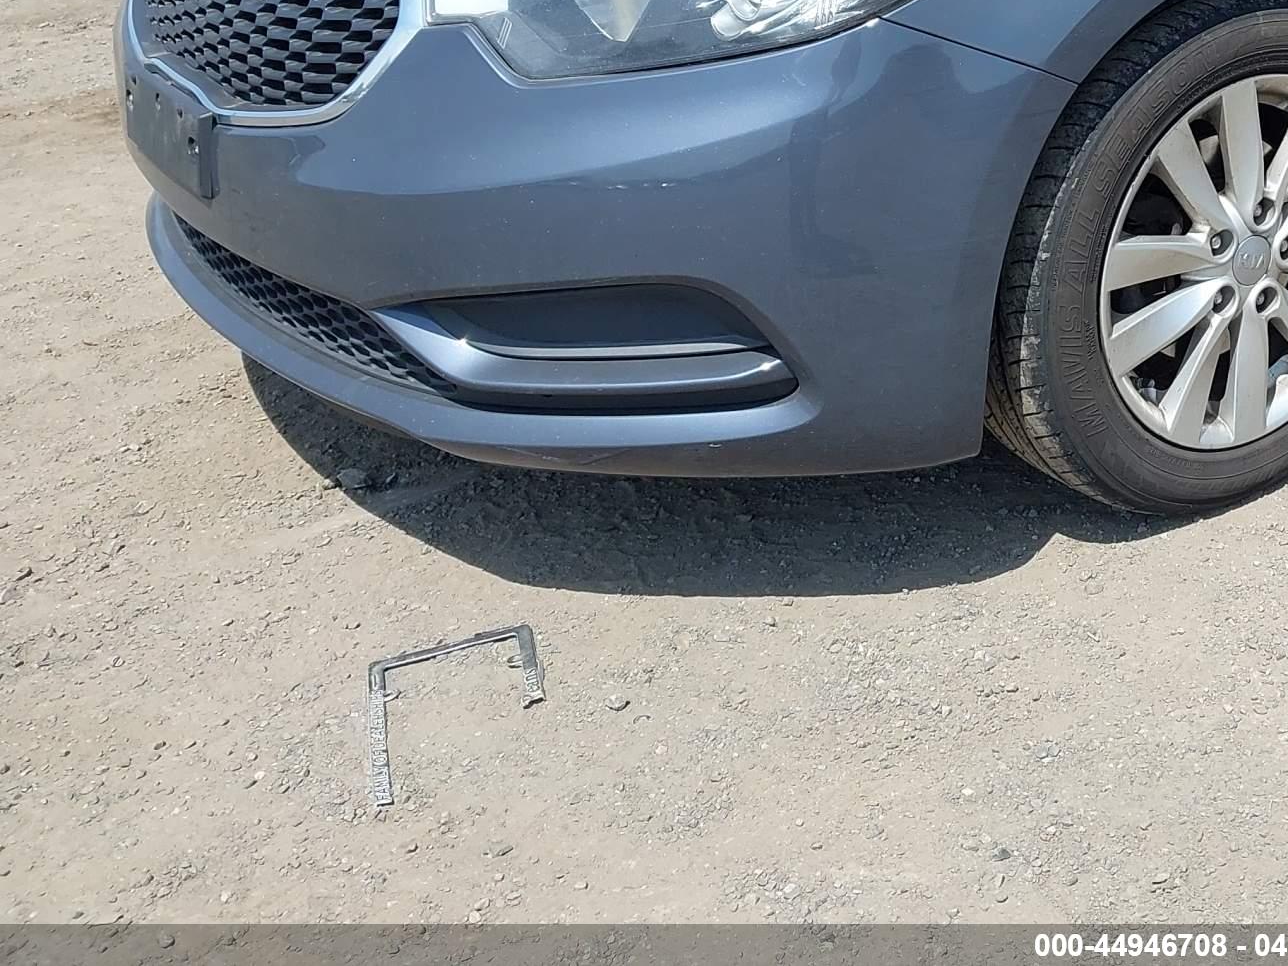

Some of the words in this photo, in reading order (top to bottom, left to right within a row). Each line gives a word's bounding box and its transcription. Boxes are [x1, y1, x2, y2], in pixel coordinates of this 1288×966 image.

[1063, 208, 1100, 295] ALL
[372, 750, 388, 766] OF
[374, 766, 391, 801] FAMILY
